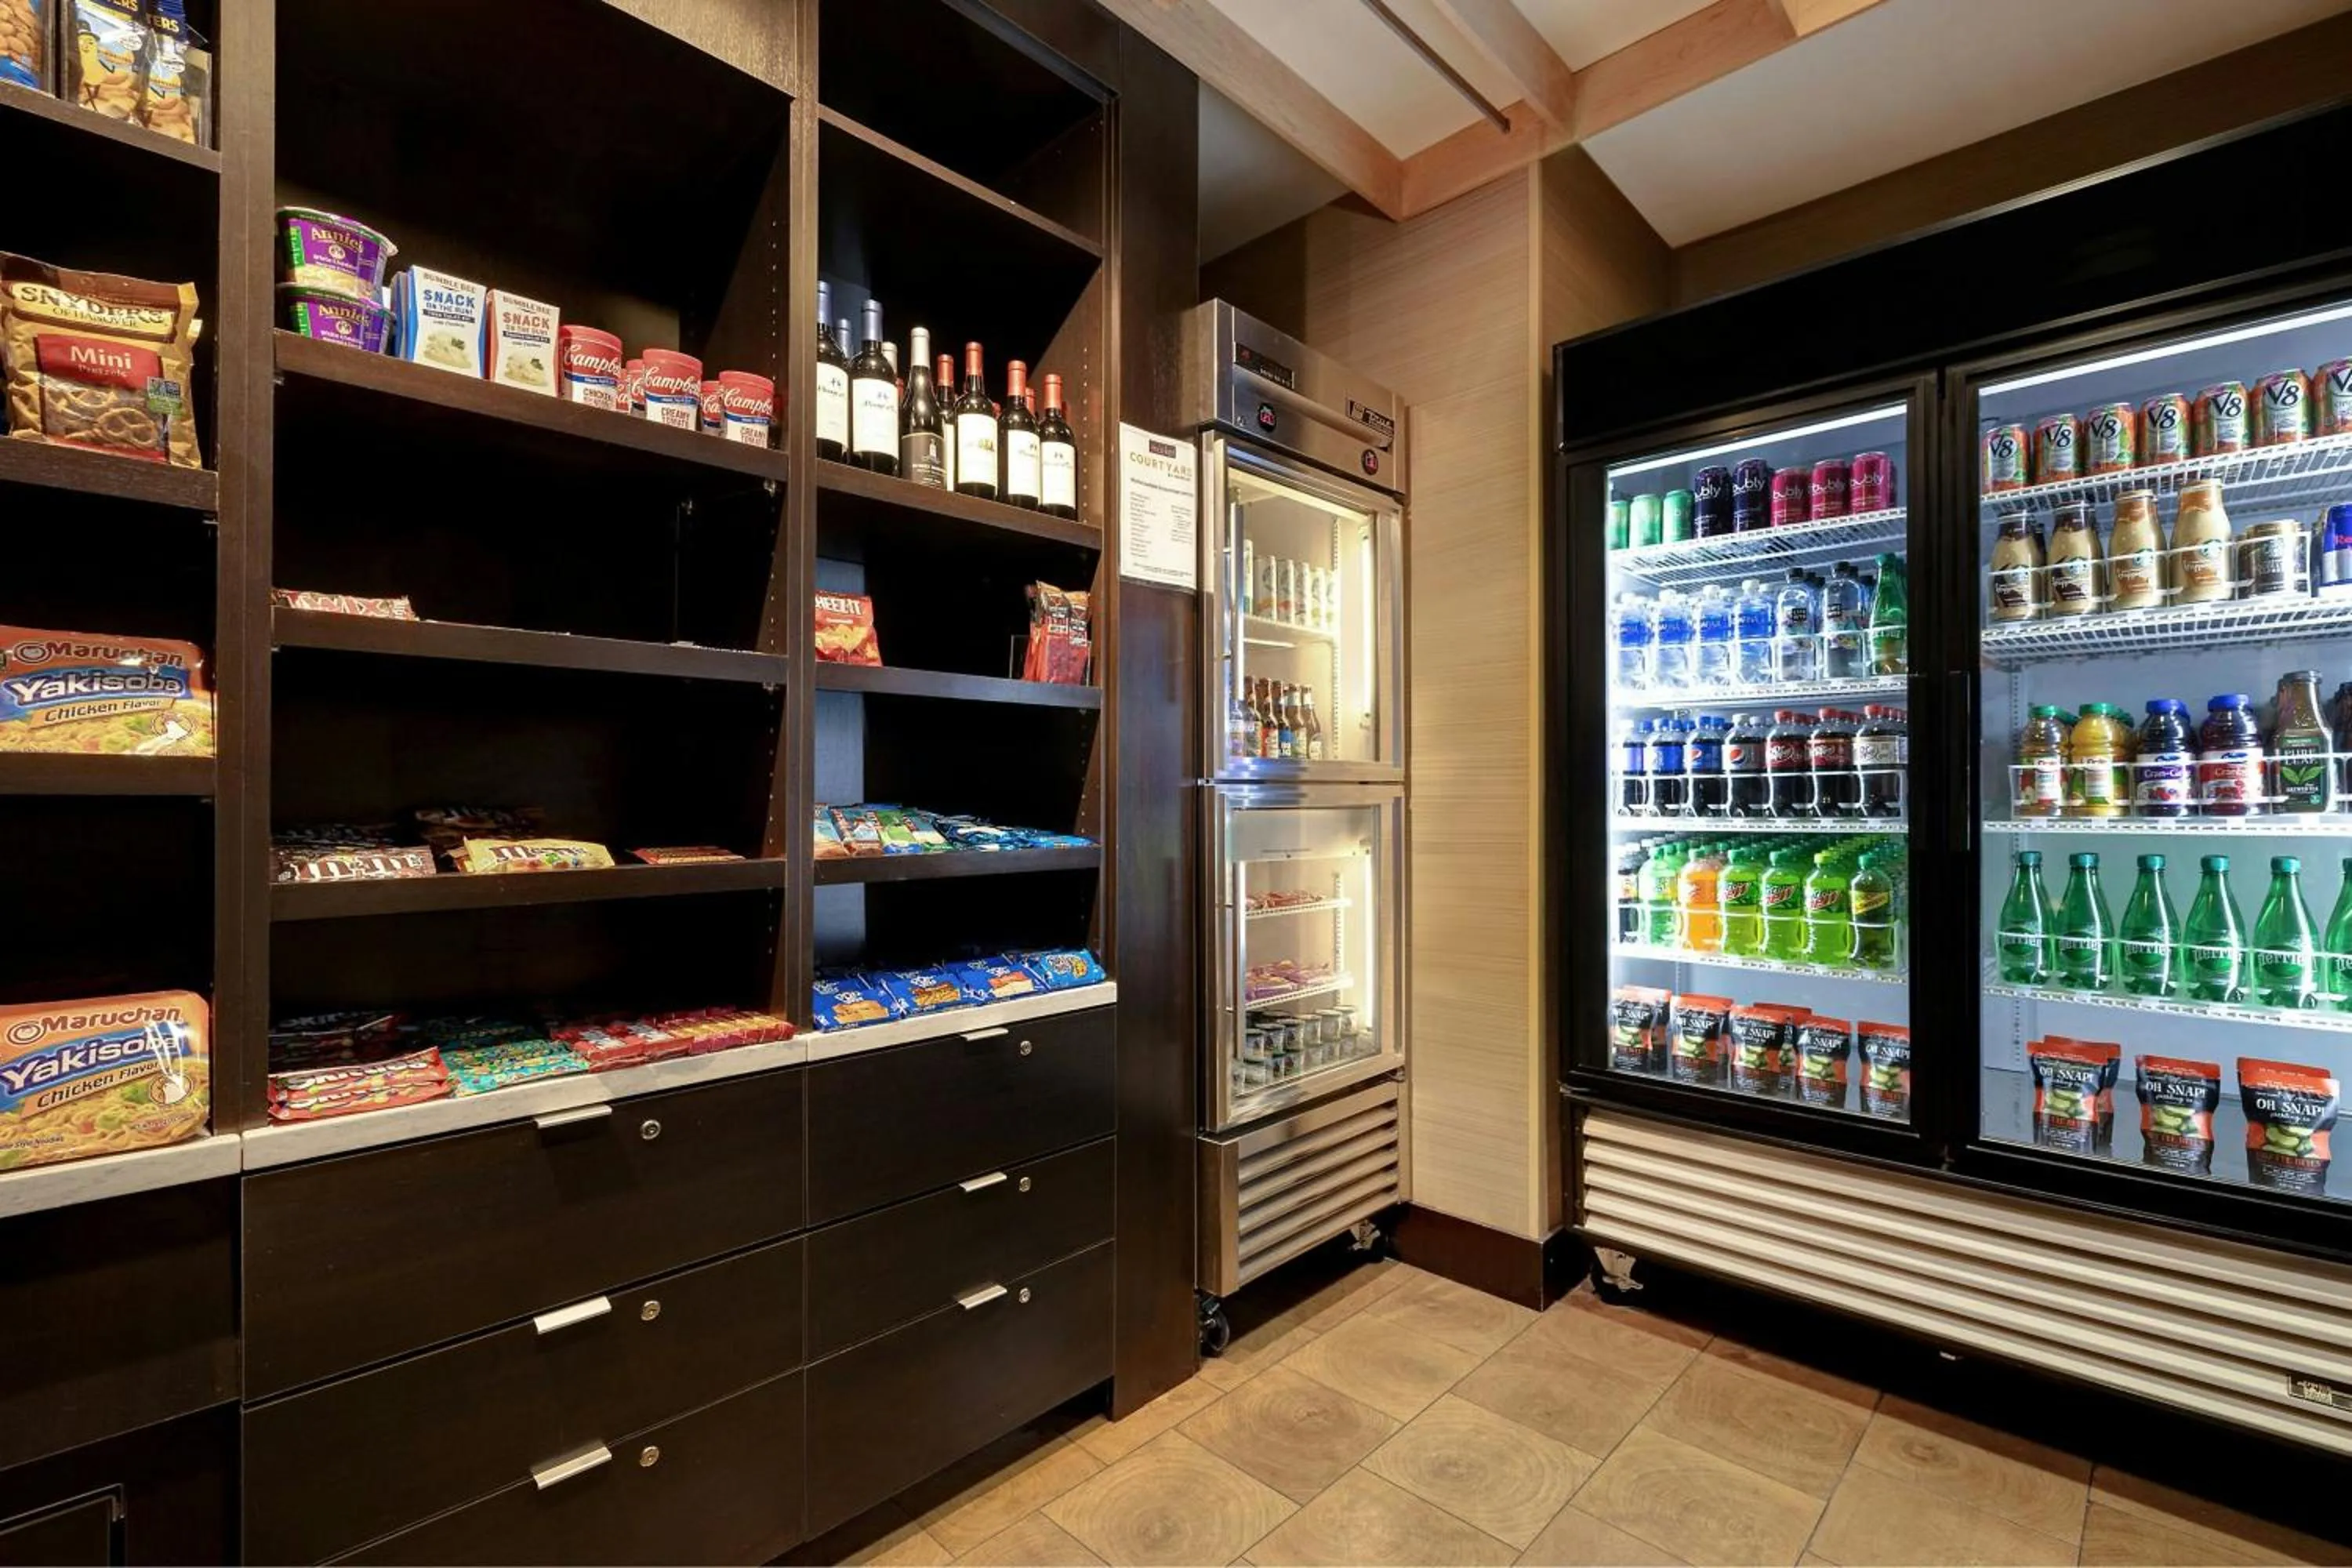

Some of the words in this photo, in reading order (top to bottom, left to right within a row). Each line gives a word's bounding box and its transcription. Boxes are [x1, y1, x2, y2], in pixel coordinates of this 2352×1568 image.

[423, 289, 476, 309] SNACK
[503, 312, 550, 331] SNACK
[71, 345, 132, 369] Mini
[2211, 391, 2241, 417] V8
[2266, 379, 2299, 406] V8
[2090, 413, 2118, 438] V8
[2147, 403, 2176, 430] V8
[1990, 434, 2013, 458] V8
[2045, 423, 2071, 448] V8
[45, 642, 183, 666] Maruchan
[11, 669, 182, 703] Yakisoba
[45, 702, 118, 723] Chicken
[122, 699, 162, 710] Flavor
[41, 1007, 182, 1032] Maruchan
[1, 1033, 180, 1090] Yakisoba
[38, 1073, 114, 1109] Chicken
[118, 1061, 162, 1080] Flavor
[2256, 1098, 2276, 1110] OH
